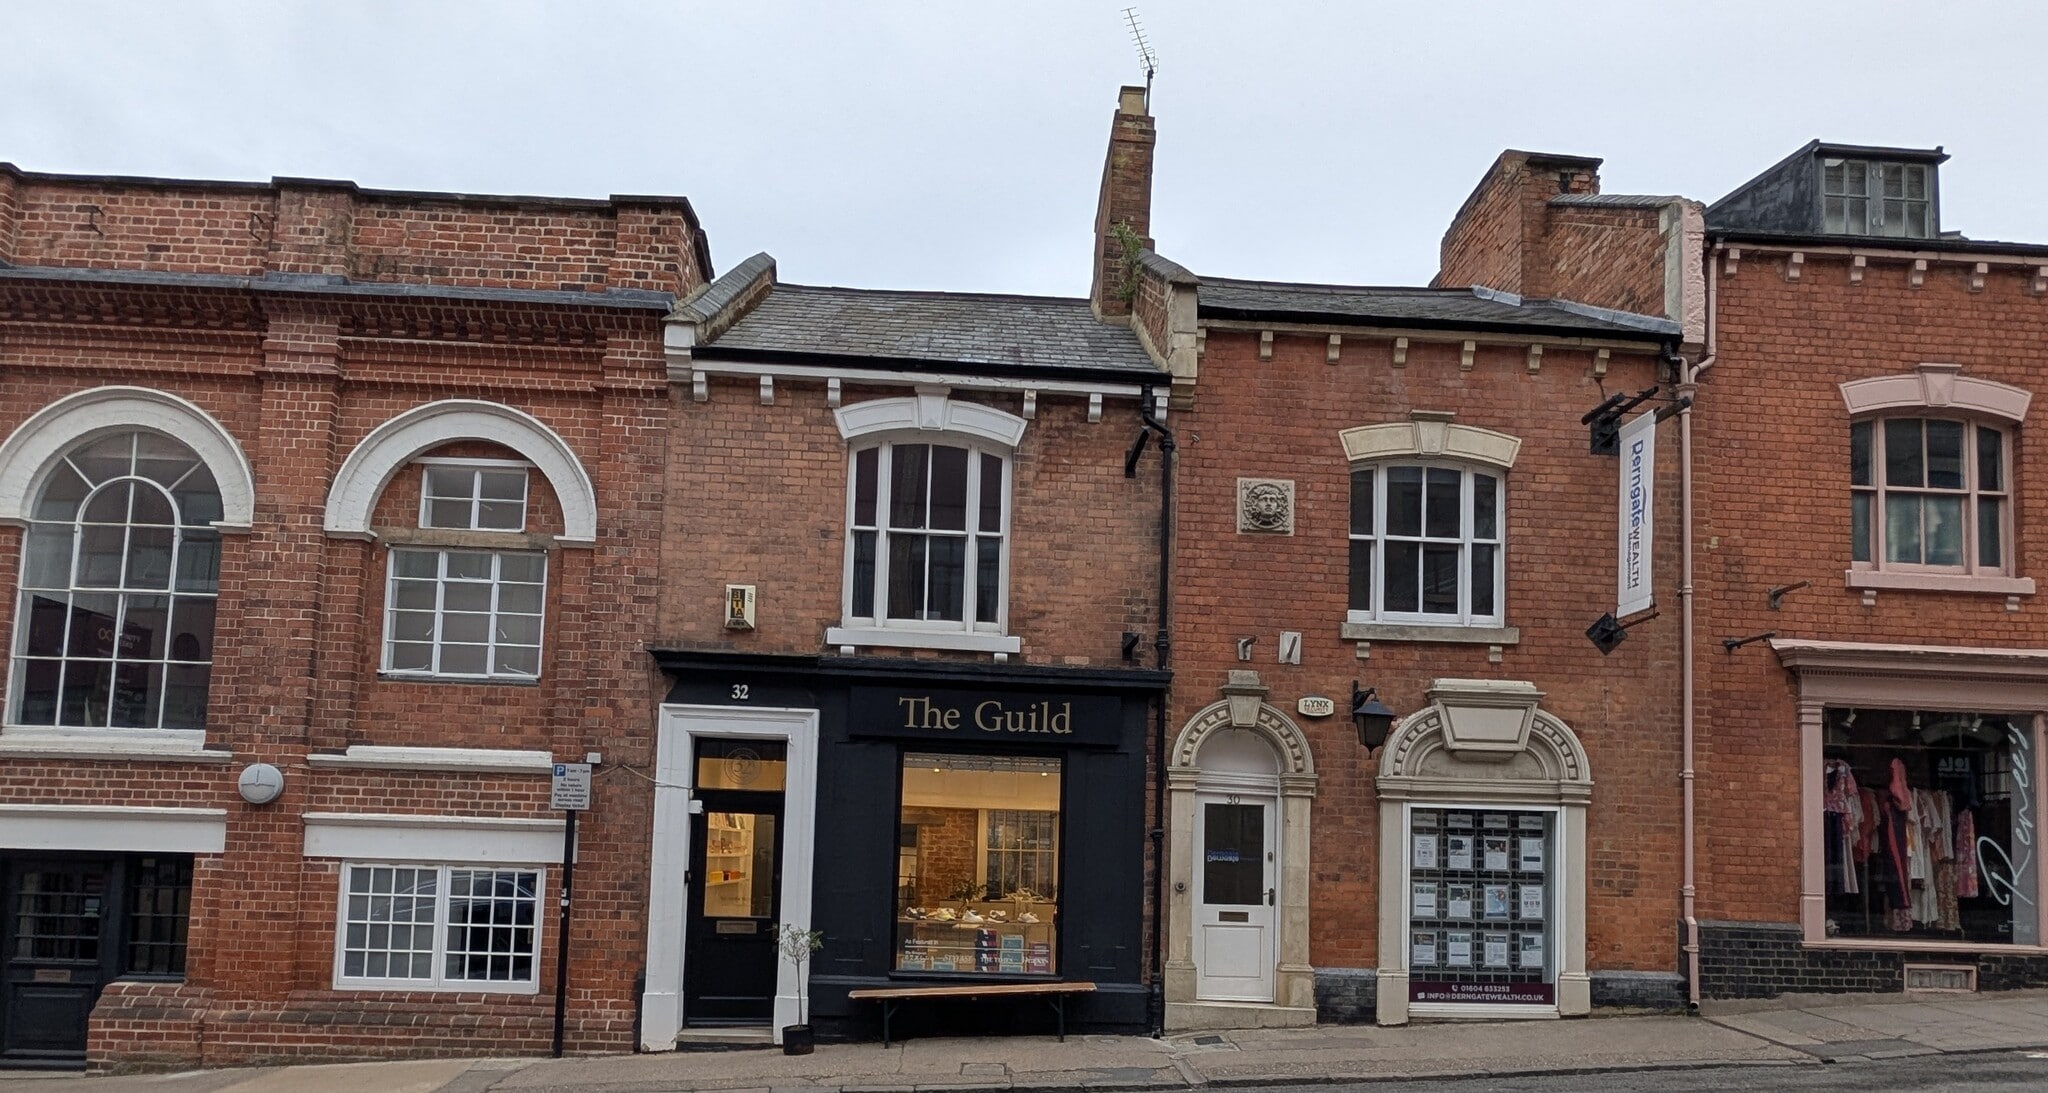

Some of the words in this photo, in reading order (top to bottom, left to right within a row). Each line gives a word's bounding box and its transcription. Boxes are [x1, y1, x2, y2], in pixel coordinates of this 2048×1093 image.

[731, 684, 749, 700] 32
[899, 696, 961, 730] The
[974, 700, 1073, 735] Guild
[1226, 795, 1240, 805] 30
[1427, 992, 1544, 1001] INFO@DERNGATEWEALTH.CO.UK
